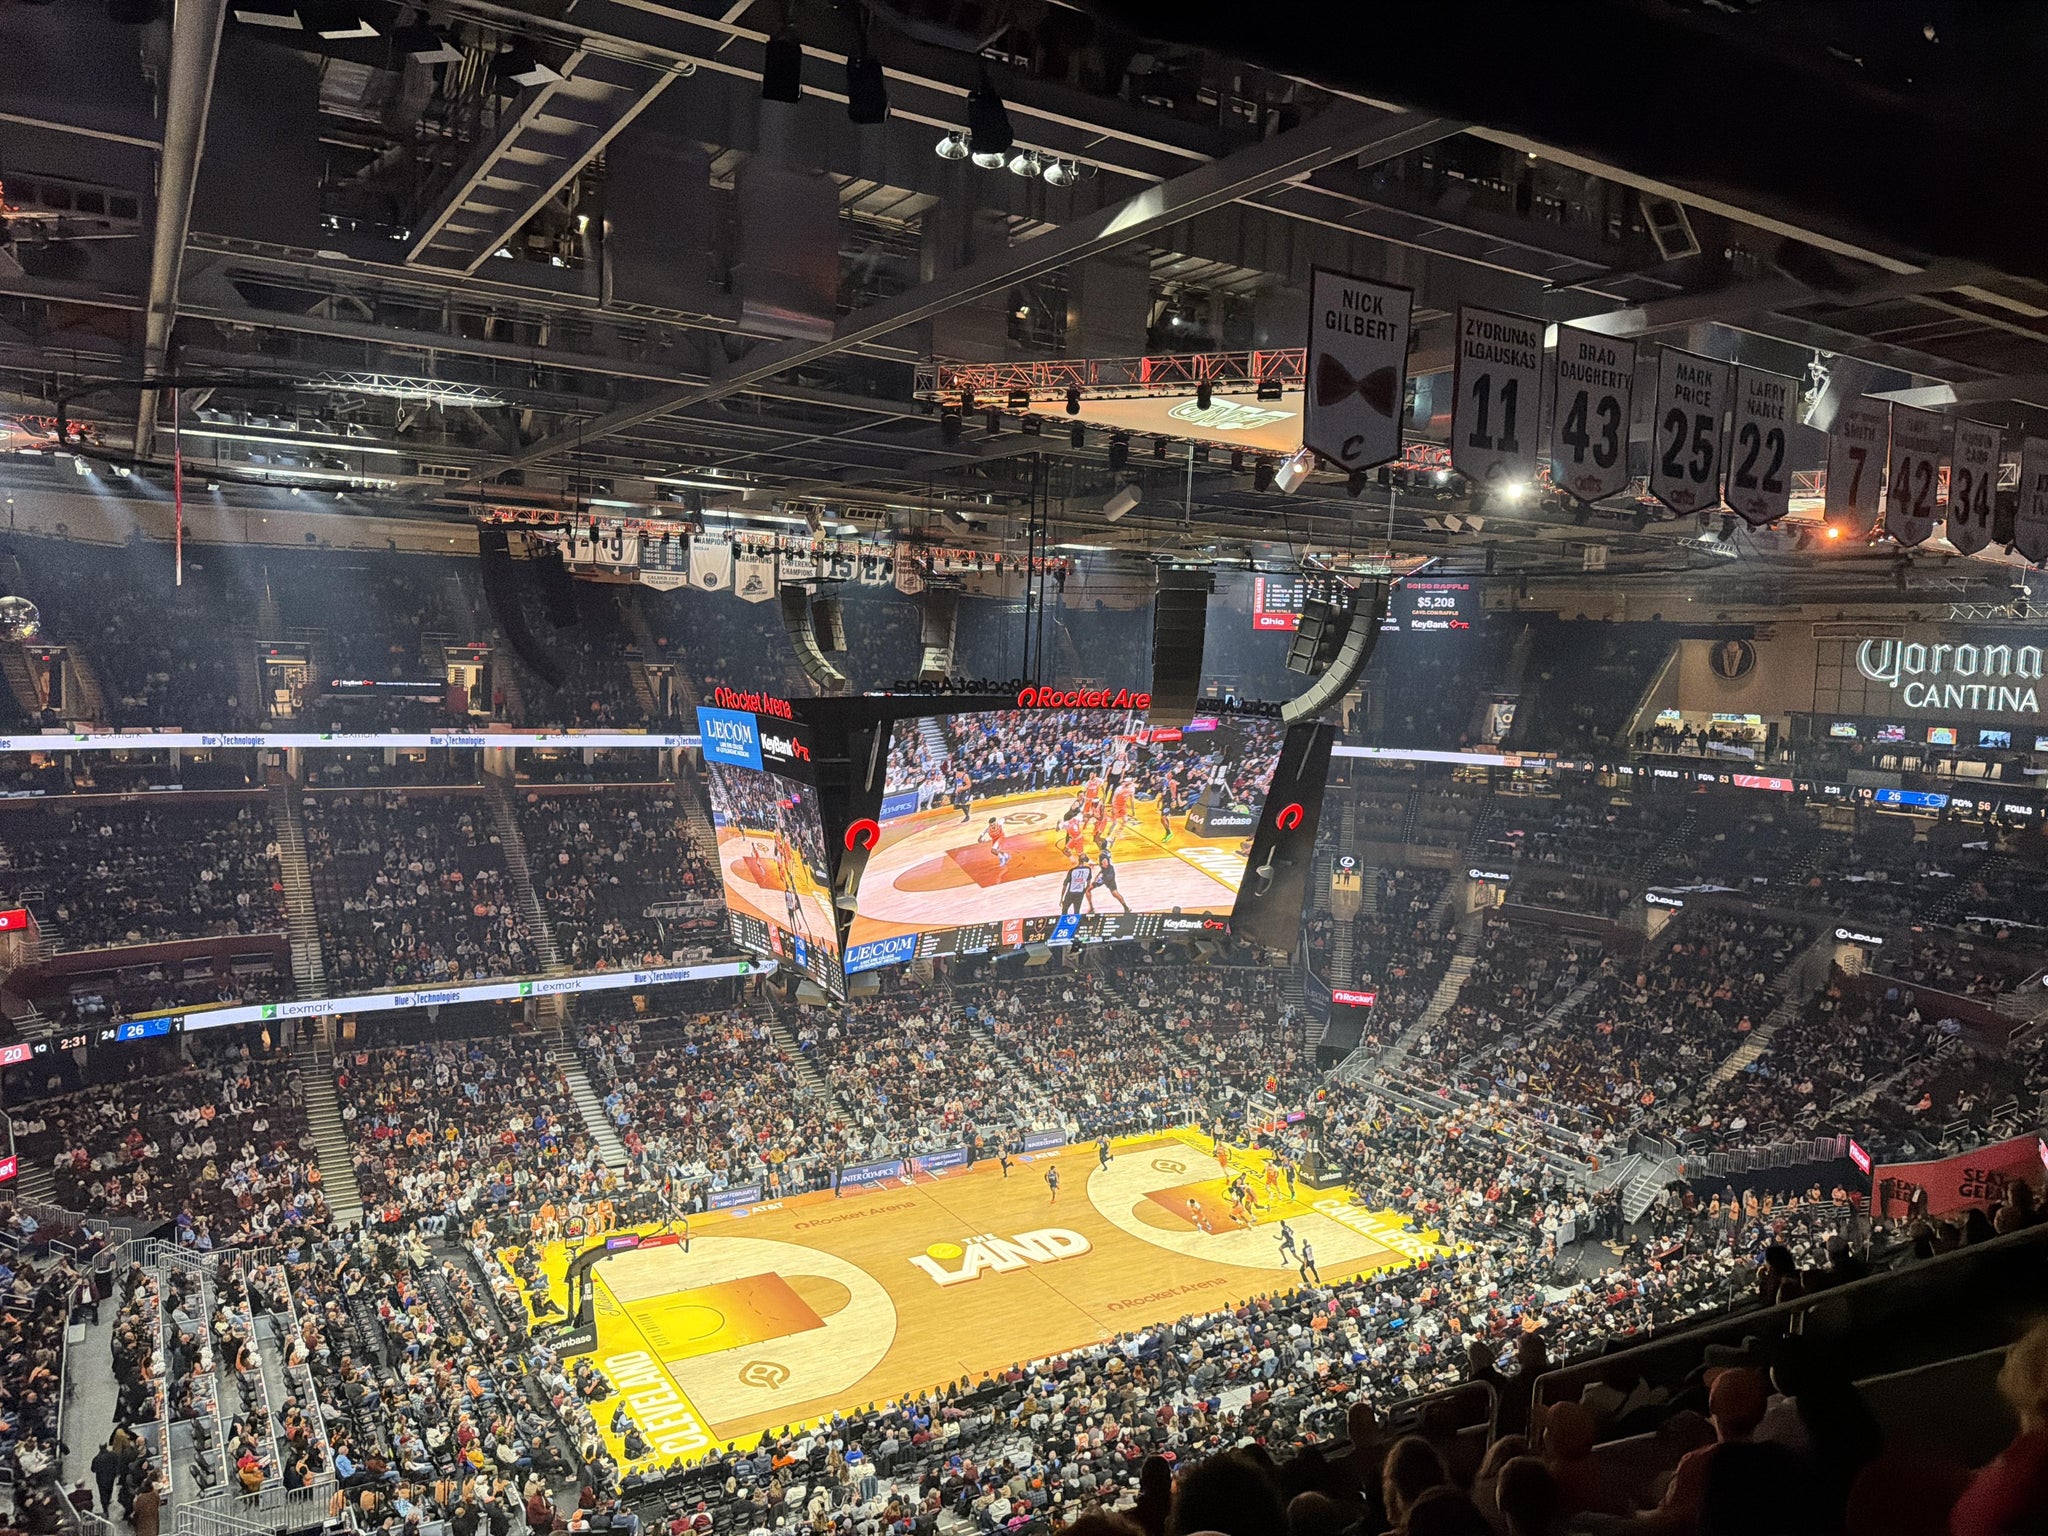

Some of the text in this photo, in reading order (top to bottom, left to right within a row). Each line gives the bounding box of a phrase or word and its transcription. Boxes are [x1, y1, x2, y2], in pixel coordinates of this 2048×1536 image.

[1343, 289, 1383, 315] NICK
[1326, 310, 1397, 342] GILBERT
[1466, 318, 1537, 349] ZYDRUNAS
[1464, 341, 1536, 370] ILGAUSKAS
[1579, 343, 1616, 366] BRAD
[1561, 360, 1632, 390] DAUGHERTY
[1676, 363, 1712, 387] MARK
[1675, 384, 1711, 408] PRICE
[1750, 379, 1786, 402] LARRY
[1469, 373, 1519, 453] 11
[1747, 399, 1785, 420] NANCE
[1562, 390, 1621, 469] 43
[1845, 423, 1875, 441] SMITH
[1661, 408, 1714, 484] 25
[1735, 422, 1785, 493] 22
[1850, 446, 1867, 508] 7
[1893, 456, 1934, 517] 42
[1955, 467, 1990, 528] 34
[611, 537, 623, 561] 9
[694, 537, 728, 546] HAMPIONS
[781, 558, 814, 567] CONFERENC
[782, 568, 814, 576] CHAMPIONS
[1417, 597, 1456, 609] $5,208
[1260, 617, 1285, 626] Ohio
[1411, 620, 1449, 630] KeyBank
[724, 687, 793, 720] Rocket Arena
[1037, 686, 1151, 710] Rocket Are
[1903, 682, 2041, 713] CANTINA
[202, 736, 216, 745] Blue
[223, 736, 265, 747] Technologies
[430, 736, 443, 745] Blue
[448, 735, 486, 747] Technologies
[664, 737, 676, 745] Blue
[705, 718, 753, 744] LECOM
[761, 733, 794, 757] KeyBank
[1619, 766, 1634, 774] TOL
[1638, 768, 1645, 776] 5
[1654, 769, 1679, 778] FOULS
[1684, 772, 1689, 780] 1
[1698, 773, 1715, 782] FG%
[1719, 775, 1730, 784] 53
[1769, 780, 1781, 789] 20
[1799, 783, 1809, 791] 24
[1824, 786, 1840, 794] 2:31
[1858, 788, 1872, 798] 1Q
[1888, 791, 1901, 801] 26
[1951, 798, 1973, 808] FG%
[1978, 801, 1991, 811] 56
[2005, 804, 2033, 815] FOULS
[2040, 809, 2046, 817] 1
[1210, 815, 1252, 826] coinbase
[1656, 896, 1684, 907] LEXUS
[1007, 929, 1069, 942] 20 2:31 26
[1163, 918, 1203, 930] KeyBank
[846, 936, 912, 963] LECOM
[1848, 932, 1883, 944] LEXUS
[282, 969, 690, 1015] Lexmark Blue Technologies Lexmark Blue Technologies
[1343, 993, 1374, 1004] Rocket
[175, 1023, 181, 1032] 1
[4, 1048, 22, 1062] 20
[61, 1035, 87, 1050] 2:31
[101, 1028, 115, 1041] 24
[127, 1024, 144, 1037] 26
[863, 1168, 894, 1180] OLYMPICS
[752, 1202, 784, 1214] AT&T
[808, 1200, 917, 1227] Rocket Arena
[961, 1232, 998, 1246] THE
[1312, 1199, 1434, 1257] CAVALIERS
[907, 1227, 1093, 1288] LAND
[1121, 1277, 1228, 1308] Rocket Arena
[550, 1333, 592, 1352] coinbase
[604, 1350, 710, 1455] CLEVELAND
